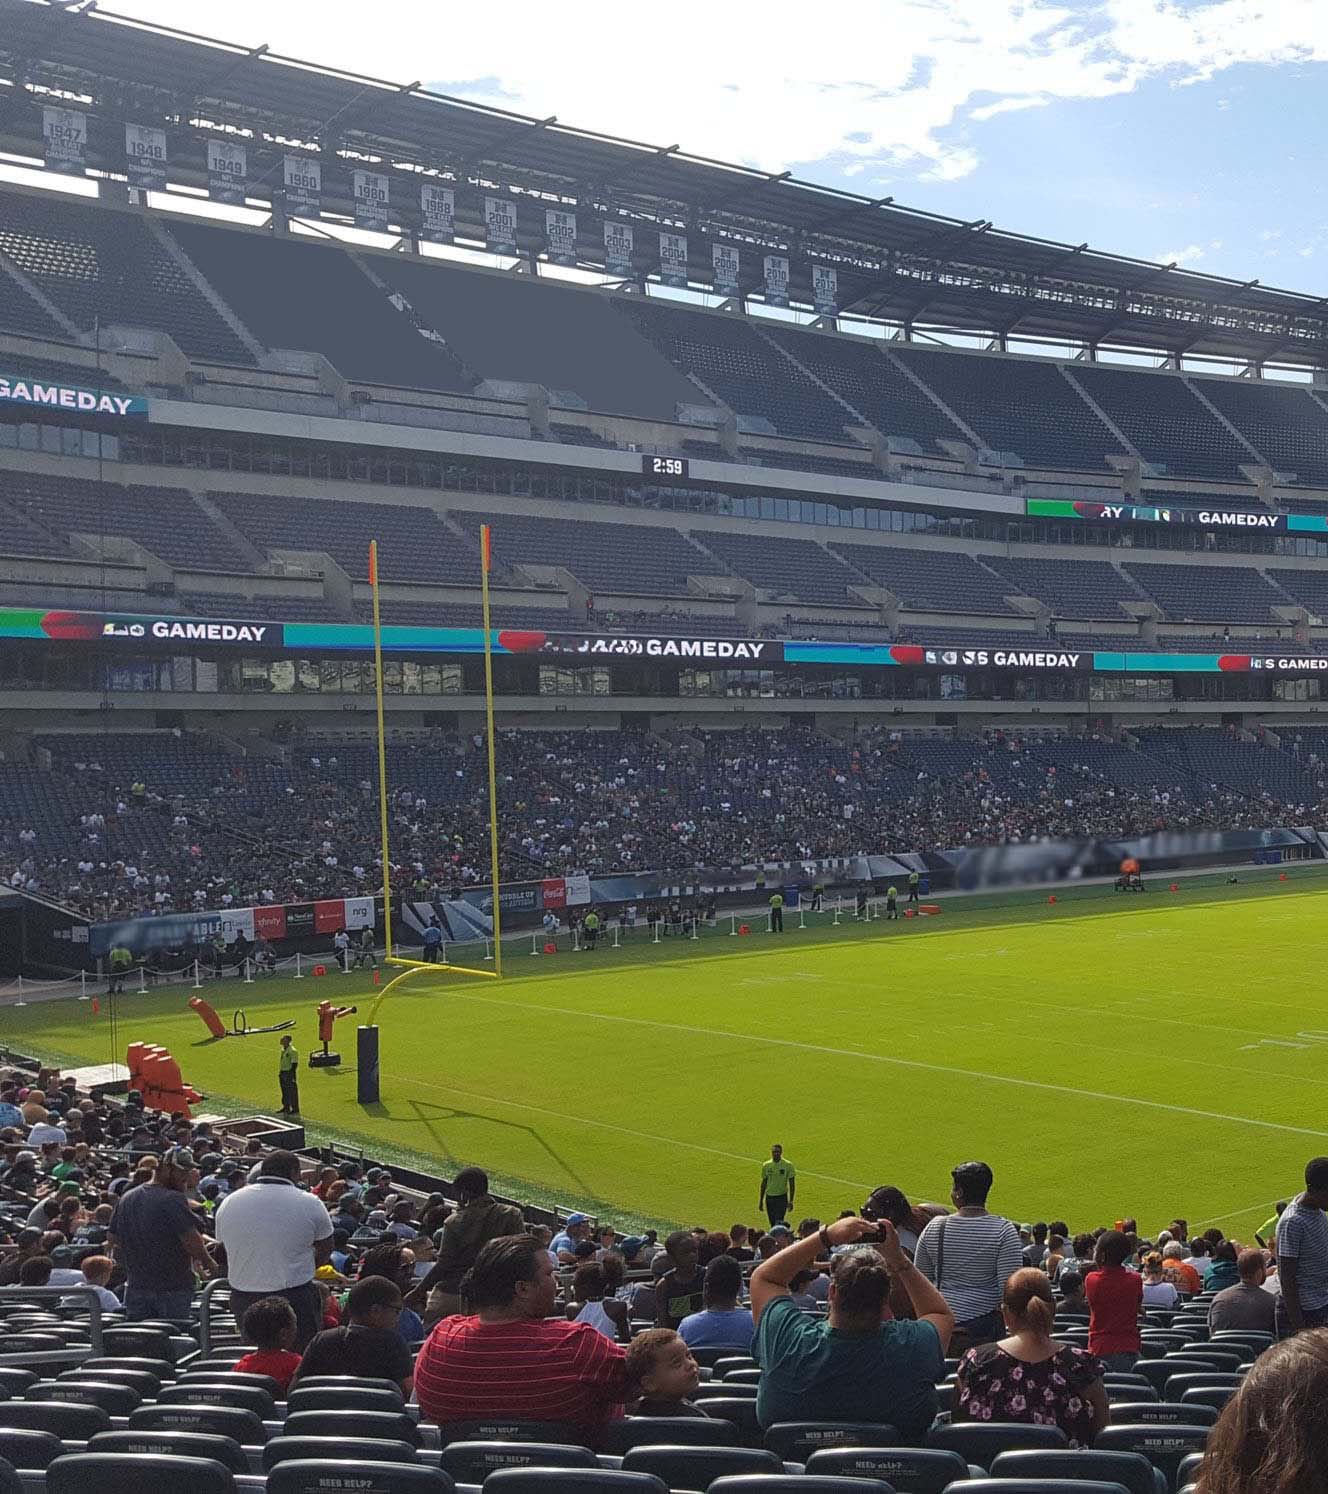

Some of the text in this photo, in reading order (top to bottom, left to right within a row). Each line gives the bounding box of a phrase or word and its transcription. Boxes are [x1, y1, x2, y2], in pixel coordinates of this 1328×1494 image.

[48, 123, 81, 140] 1947
[130, 142, 162, 158] 1948
[212, 158, 242, 174] 1949
[289, 173, 317, 188] 1960
[358, 185, 385, 200] 1980
[425, 199, 450, 213] 1988
[489, 212, 512, 226] 2001
[549, 224, 573, 238] 2002
[606, 235, 630, 249] 2003
[662, 246, 685, 261] 2004
[653, 458, 682, 475] 2:59
[1199, 512, 1278, 527] GAMEDAY
[152, 621, 266, 641] GAMEDAY
[646, 640, 764, 658] GAMEDAY
[994, 652, 1080, 667] GAMEDAY
[352, 906, 367, 917] nrg
[319, 1479, 343, 1487] NEED
